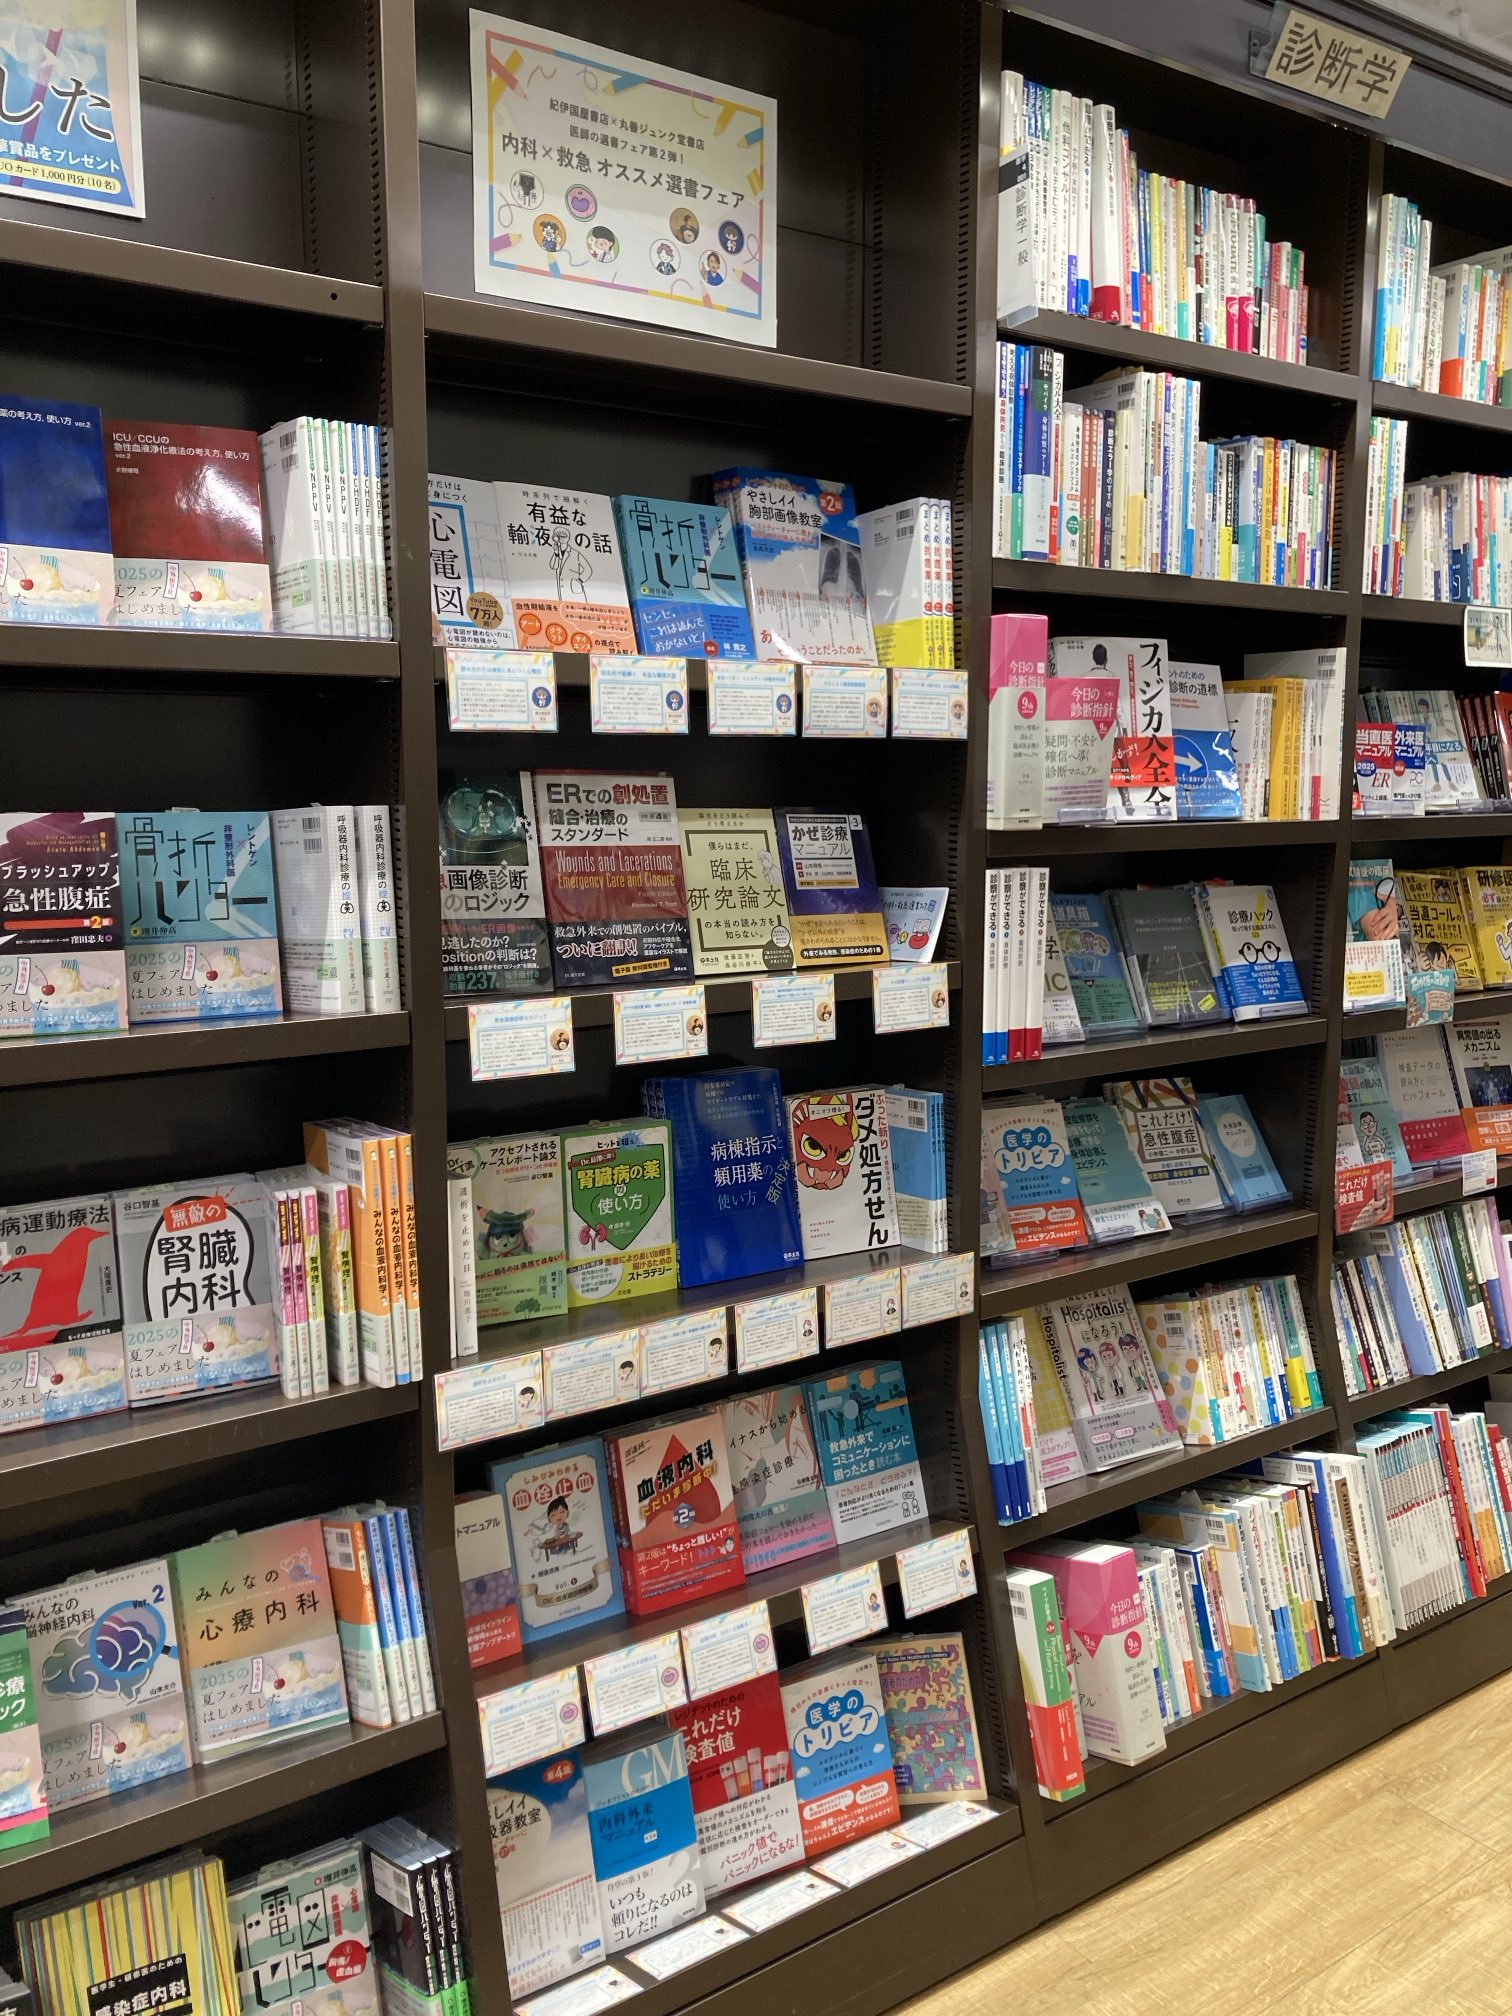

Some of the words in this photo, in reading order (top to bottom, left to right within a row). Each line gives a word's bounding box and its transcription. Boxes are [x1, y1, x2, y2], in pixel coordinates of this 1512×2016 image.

[1275, 22, 1397, 103] 診断学
[549, 97, 705, 151] 紀伊国屋書店×丸善ジュンク堂書店
[569, 124, 684, 165] 医師の選書フェア第2弾!
[501, 131, 592, 174] 内科×救急
[597, 158, 745, 208] オススメ選書フェア
[1053, 357, 1062, 420] フィジカル大全
[309, 473, 318, 512] NPPV
[324, 474, 332, 514] NPPV
[339, 476, 348, 515] NPPV
[747, 489, 796, 509] やさしイイ
[526, 501, 587, 527] 有益な
[630, 499, 695, 552] 骨折
[748, 504, 822, 529] 胸部画像教室
[507, 522, 613, 554] 輸液の話
[714, 515, 725, 550] レントゲン
[430, 511, 465, 616] 心電図
[470, 596, 498, 605] YouTube
[469, 607, 501, 621] 7万人
[520, 620, 542, 629] アート
[446, 628, 511, 639] 心電図が読めないのは、
[447, 635, 498, 645] 心電図の勉強から
[650, 618, 705, 640] これは読んで
[655, 631, 707, 653] おかないと!
[1009, 661, 1034, 674] 今日の
[1070, 687, 1100, 701] 今日の
[1070, 702, 1114, 719] 診断指針
[1356, 730, 1393, 745] 当直医
[1394, 731, 1425, 746] 外来医
[1356, 745, 1392, 758] マニュアル
[1394, 745, 1424, 758] マニュアル
[1357, 762, 1375, 771] 2025
[1371, 772, 1390, 788] ER
[547, 782, 670, 806] ERでの創処置
[549, 808, 628, 827] 縫合・治療の
[246, 824, 258, 867] レントゲン
[551, 826, 629, 842] スタンダード
[707, 840, 755, 852] 僕らはまだ、
[791, 825, 850, 843] かぜ診療
[125, 817, 216, 877] 骨折
[793, 842, 852, 857] マニュアル
[1, 862, 110, 880] ブラッシュアップ
[555, 851, 595, 873] Wounds
[598, 855, 616, 871] and
[619, 852, 674, 872] Lacerations
[709, 857, 758, 882] 臨床
[557, 873, 603, 891] Emergency
[606, 874, 624, 888] Care
[627, 873, 641, 888] and
[644, 874, 675, 888] Closure
[2, 886, 112, 913] 急性腹症
[445, 891, 530, 913] のロジック
[687, 884, 786, 912] 研究論文
[704, 917, 776, 929] の本当の読み方を
[1227, 908, 1274, 924] 診療ハック
[554, 922, 687, 939] 救急外来での創処置のバイブル、
[724, 930, 765, 940] 知らない。
[130, 953, 181, 967] 2025の
[131, 969, 180, 984] 夏フェア
[466, 971, 498, 991] 237
[132, 983, 213, 1000] はじめました
[1464, 1041, 1501, 1053] メカニズム
[875, 1094, 889, 1150] ぶった斬り
[1140, 1110, 1194, 1128] これだけ!
[489, 1140, 558, 1159] アクセプトされる
[710, 1135, 784, 1163] 病棟指示と
[1006, 1135, 1047, 1148] 医学の
[1144, 1128, 1198, 1148] 急性腹症
[480, 1151, 558, 1170] ケースレポート論文
[855, 1093, 889, 1247] ダメ処方せん
[1001, 1149, 1060, 1170] トリビア
[577, 1159, 661, 1190] 腎臓病の薬
[1338, 1176, 1369, 1192] これだけ
[123, 1199, 160, 1211] 谷口智基
[597, 1194, 643, 1216] 使い方
[717, 1189, 757, 1211] 使い方
[1, 1206, 111, 1238] 病運動療法
[169, 1202, 222, 1228] 無敵の
[459, 1186, 471, 1273] 透析を止めた日
[157, 1229, 239, 1277] 腎臓
[628, 1266, 673, 1283] ストラテジー
[161, 1268, 241, 1319] 内科
[1060, 1298, 1131, 1324] Hospitalist
[127, 1326, 179, 1346] 2025の
[1081, 1311, 1126, 1341] になろう!
[128, 1342, 178, 1362] 夏フェア
[1042, 1316, 1067, 1381] Hospitalist
[130, 1356, 211, 1380] はじめました
[828, 1431, 874, 1455] 救急外来で
[831, 1434, 911, 1466] コミュニケーションに
[636, 1438, 715, 1504] 血液内科
[833, 1454, 902, 1482] 困ったとき読む本
[512, 1474, 595, 1511] 血栓止血
[637, 1551, 694, 1577] キーワード!
[152, 1584, 165, 1603] 2
[195, 1568, 280, 1602] みんなの
[199, 1590, 320, 1642] 心療内科
[1109, 1598, 1131, 1614] 今日の
[1110, 1605, 1144, 1631] 診断指針
[200, 1666, 250, 1690] 2025の
[202, 1682, 249, 1707] 夏フェア
[203, 1693, 282, 1725] はじめました
[808, 1695, 859, 1726] 医学の
[801, 1711, 874, 1753] トリビア
[720, 1831, 779, 1869] パニック値で
[723, 1834, 800, 1884] パニックになるな!
[608, 1885, 646, 1909] いつも
[610, 1881, 694, 1927] 頼りになるのは
[613, 1918, 658, 1945] コレだ!!
